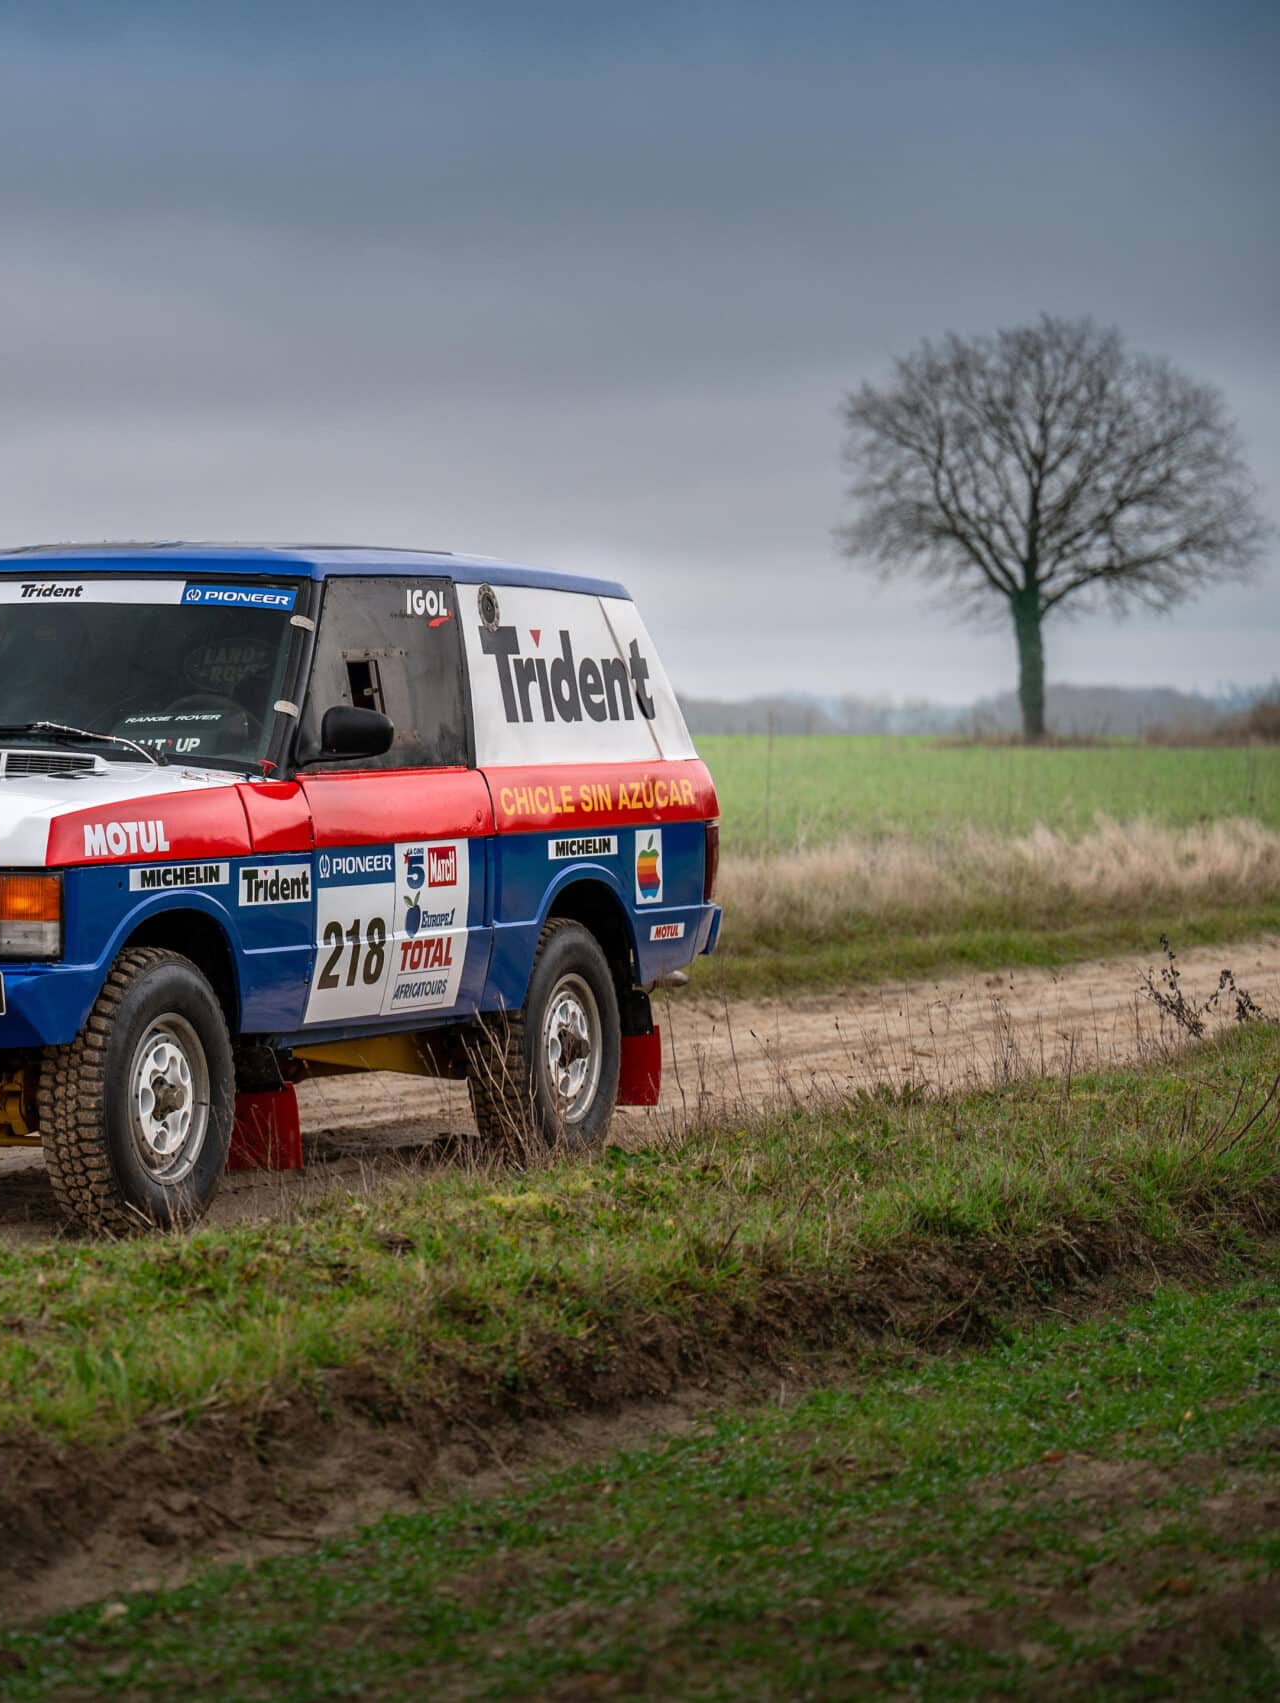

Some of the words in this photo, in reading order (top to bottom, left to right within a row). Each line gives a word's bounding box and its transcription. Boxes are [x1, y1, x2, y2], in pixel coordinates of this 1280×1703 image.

[20, 584, 83, 598] Trident
[204, 591, 289, 606] PIONEER
[406, 589, 448, 616] IGOL
[478, 625, 657, 723] Trident
[124, 715, 172, 724] RANGE
[174, 714, 222, 722] ROVER
[500, 785, 576, 816] CHICLE
[578, 783, 611, 813] SIN
[618, 774, 696, 811] AZÚCAR
[83, 820, 170, 857] MOTUL
[555, 837, 611, 857] MICHELIN
[332, 854, 392, 875] PIONEER
[140, 865, 220, 889] MICHELIN
[242, 869, 309, 903] Trident
[654, 925, 679, 939] MOTUL
[317, 917, 386, 990] 218
[400, 936, 453, 972] TOTAL
[393, 979, 448, 1001] AFRICATOURS
